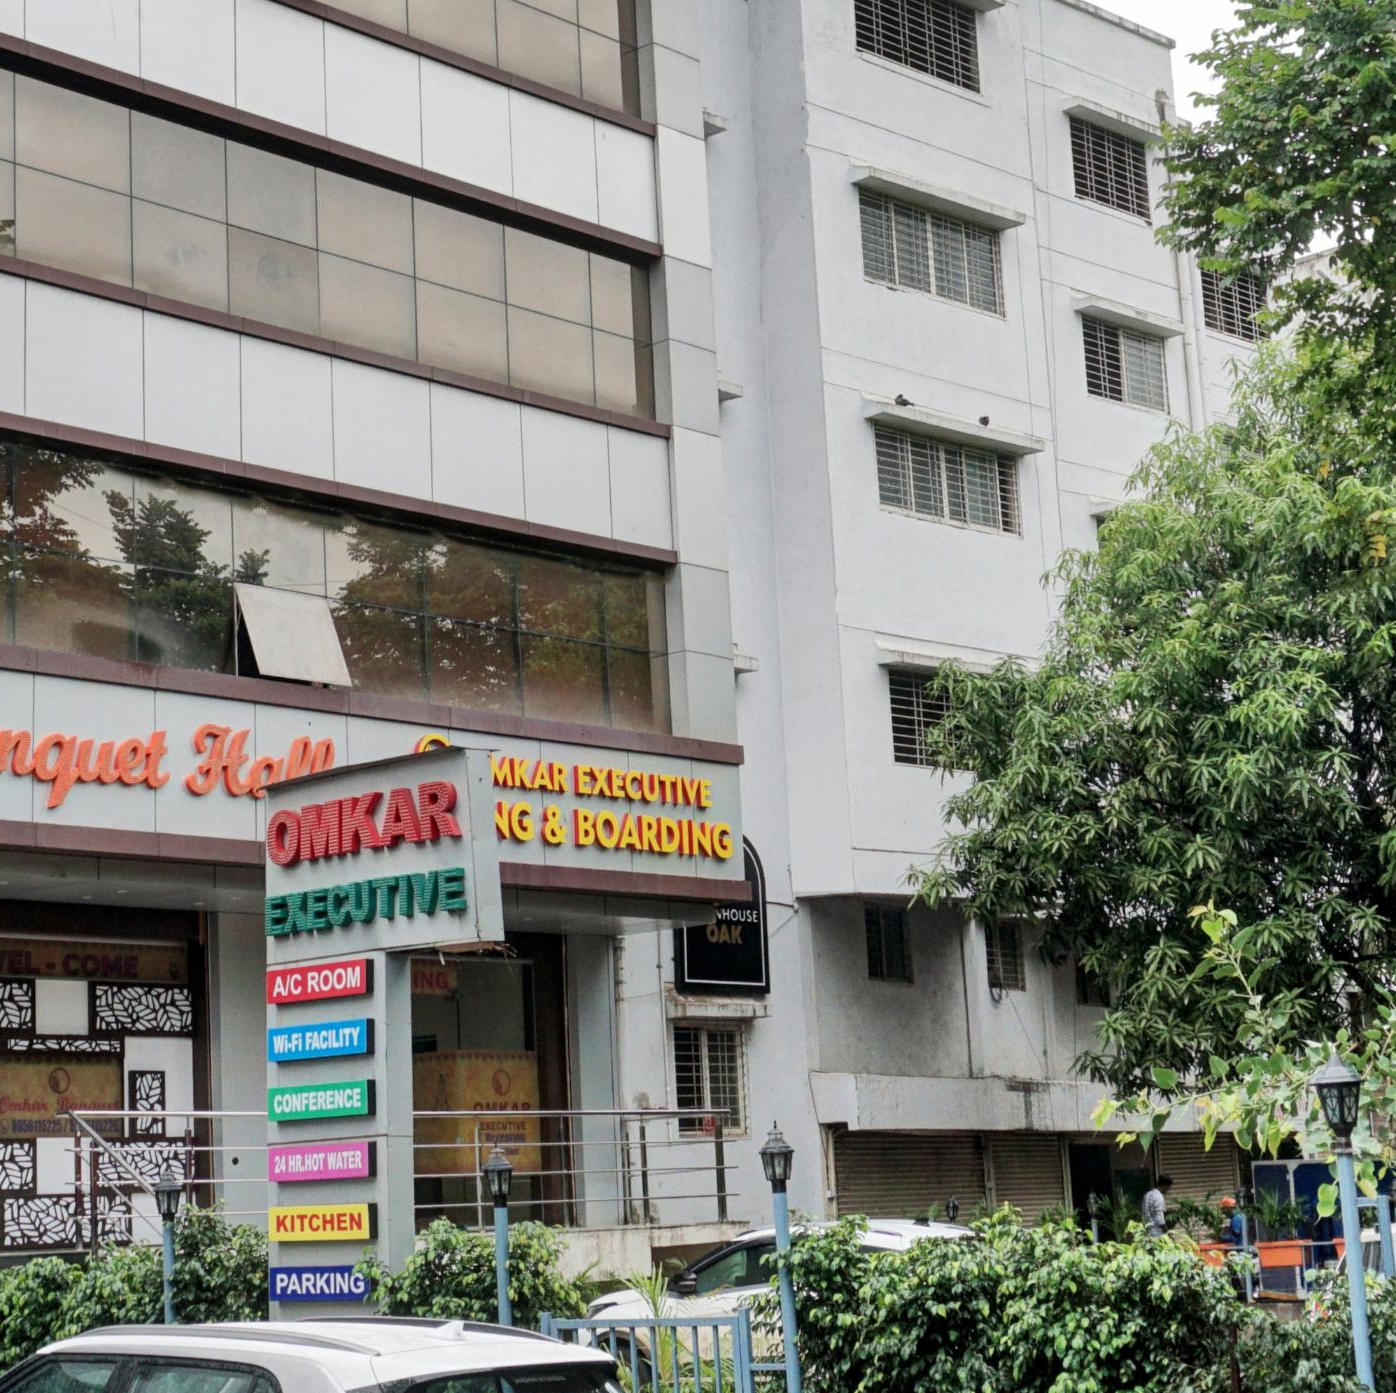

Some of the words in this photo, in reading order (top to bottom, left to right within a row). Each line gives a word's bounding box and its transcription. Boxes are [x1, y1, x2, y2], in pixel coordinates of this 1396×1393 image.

[185, 723, 336, 800] Hall
[490, 755, 569, 793] MKAR
[572, 764, 714, 810] EXECUTIVE
[267, 781, 463, 866] OMKAR
[540, 804, 567, 845] &
[572, 808, 734, 860] BOARDING
[264, 867, 468, 937] EXECUTIVE
[706, 923, 743, 945] OAK
[61, 952, 140, 979] COME
[272, 973, 303, 998] A/C
[307, 966, 361, 994] ROOM
[413, 971, 449, 990] ING
[273, 1032, 302, 1054] Wi-Fi
[305, 1026, 361, 1051] FACILITY
[273, 1088, 362, 1114] CONFERENCE
[480, 1120, 527, 1131] EXECUTIVE
[274, 1154, 286, 1174] 24
[327, 1150, 363, 1170] WATER
[276, 1212, 363, 1233] KITCHEN
[276, 1271, 366, 1295] PARKING
